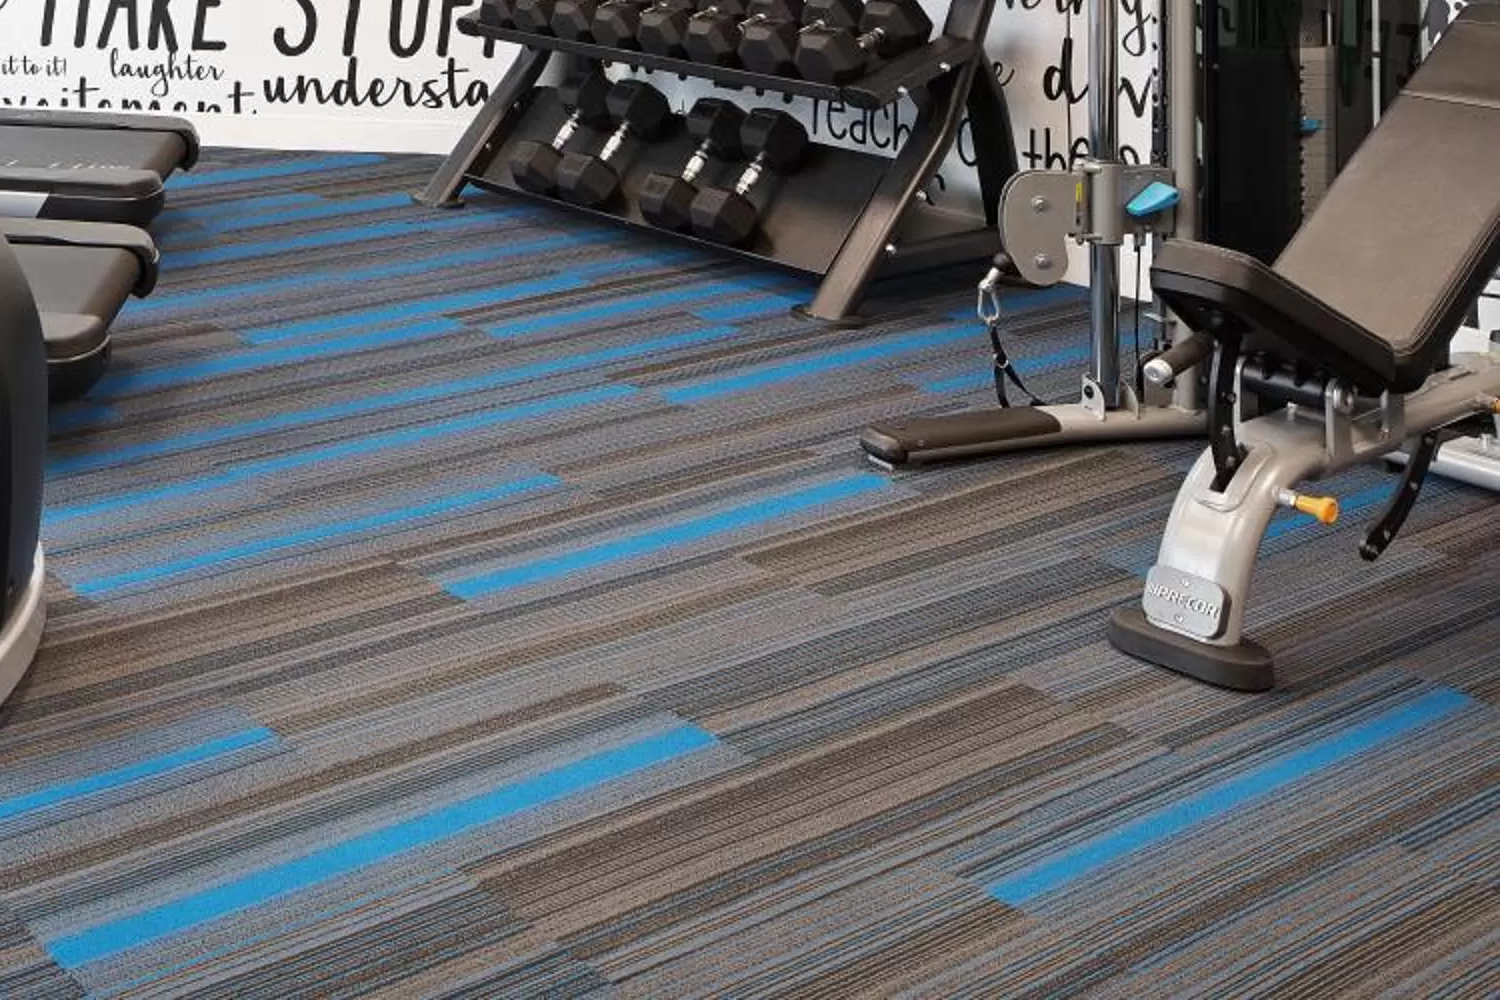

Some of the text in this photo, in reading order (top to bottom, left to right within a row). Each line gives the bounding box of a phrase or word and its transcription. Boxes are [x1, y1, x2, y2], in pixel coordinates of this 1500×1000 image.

[18, 55, 40, 75] to
[109, 50, 225, 96] laughter
[263, 57, 490, 108] understa
[1158, 582, 1220, 619] PRECOR
